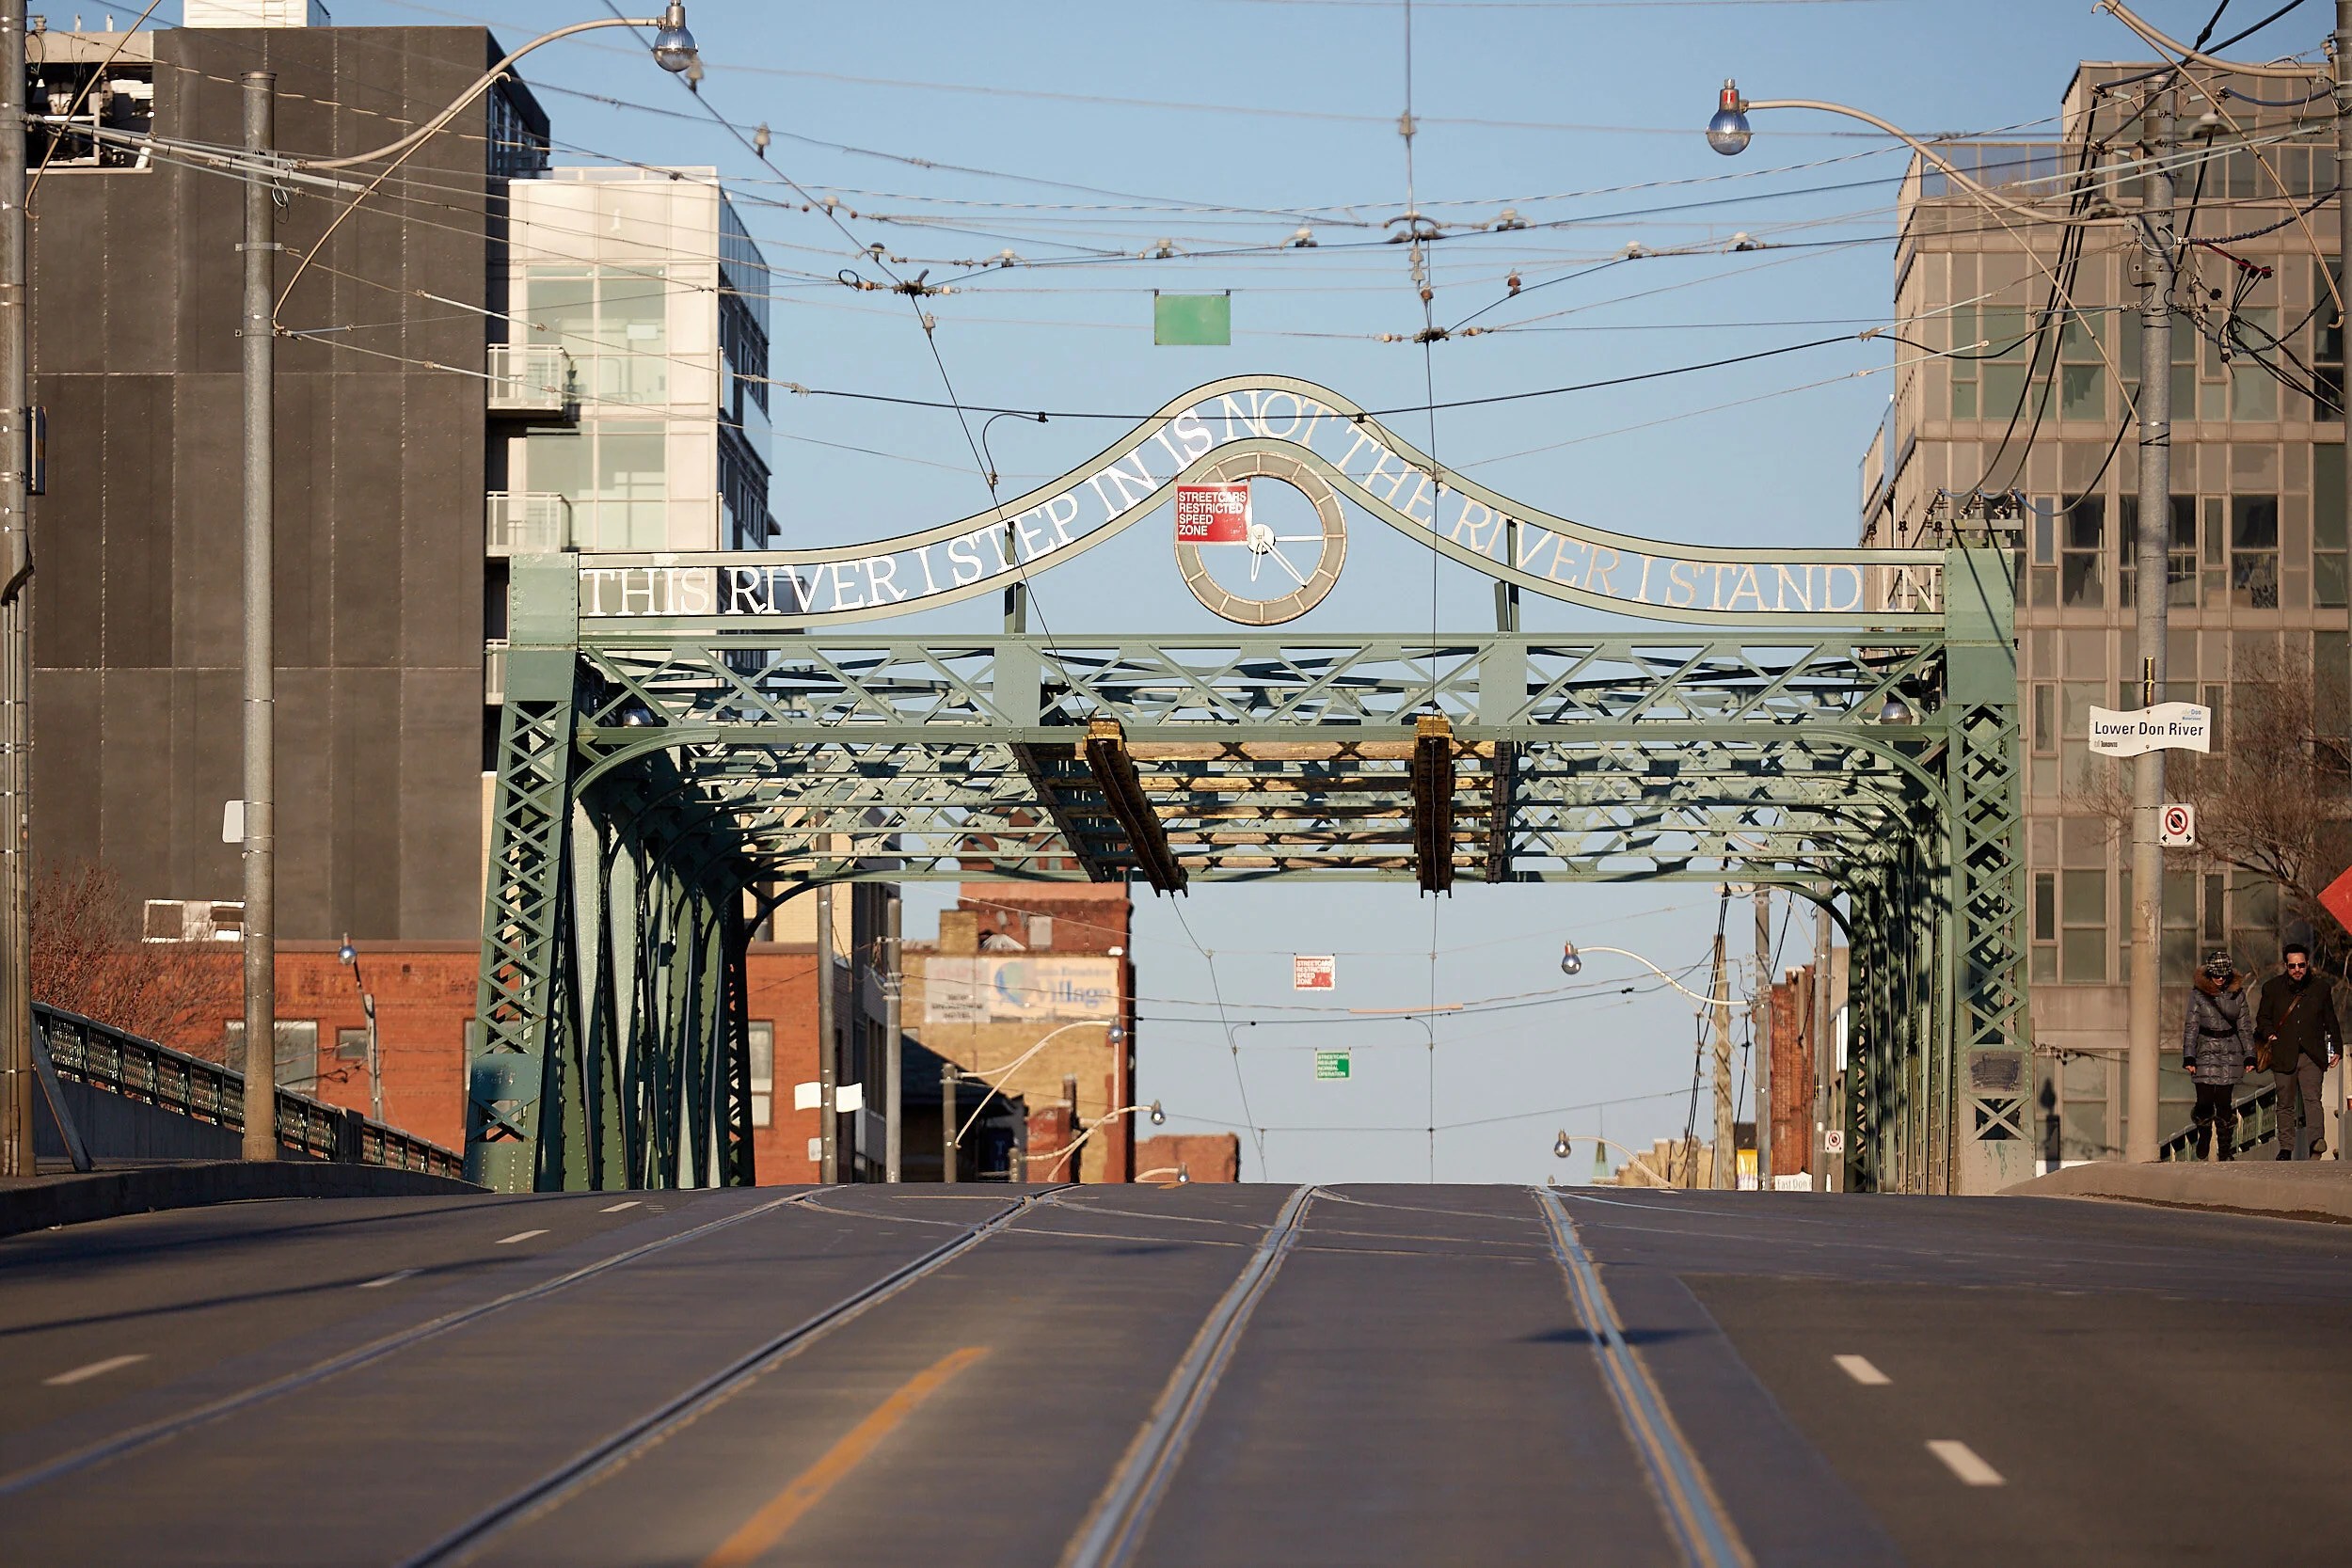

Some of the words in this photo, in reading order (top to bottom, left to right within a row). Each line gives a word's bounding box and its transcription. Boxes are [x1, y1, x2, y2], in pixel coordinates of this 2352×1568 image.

[1179, 491, 1248, 502] STREETCARS
[578, 566, 710, 616] THIS
[724, 555, 908, 614] RIVER
[912, 545, 943, 594] I
[947, 493, 1078, 587] STEP
[1086, 448, 1169, 523] IN
[1151, 407, 1214, 473] IS
[1216, 389, 1339, 447] NOT
[1332, 422, 1450, 527] THE
[1444, 495, 1620, 596] RIVER
[1631, 553, 1658, 603] I
[1664, 561, 1862, 612] STAND
[1876, 564, 1941, 612] IN
[1179, 503, 1244, 515] RESTRICTED
[1179, 515, 1214, 525] SPEED
[1179, 525, 1208, 536] ZONE
[2094, 721, 2136, 736] Lower
[2138, 721, 2164, 736] Don
[2169, 722, 2204, 736] River
